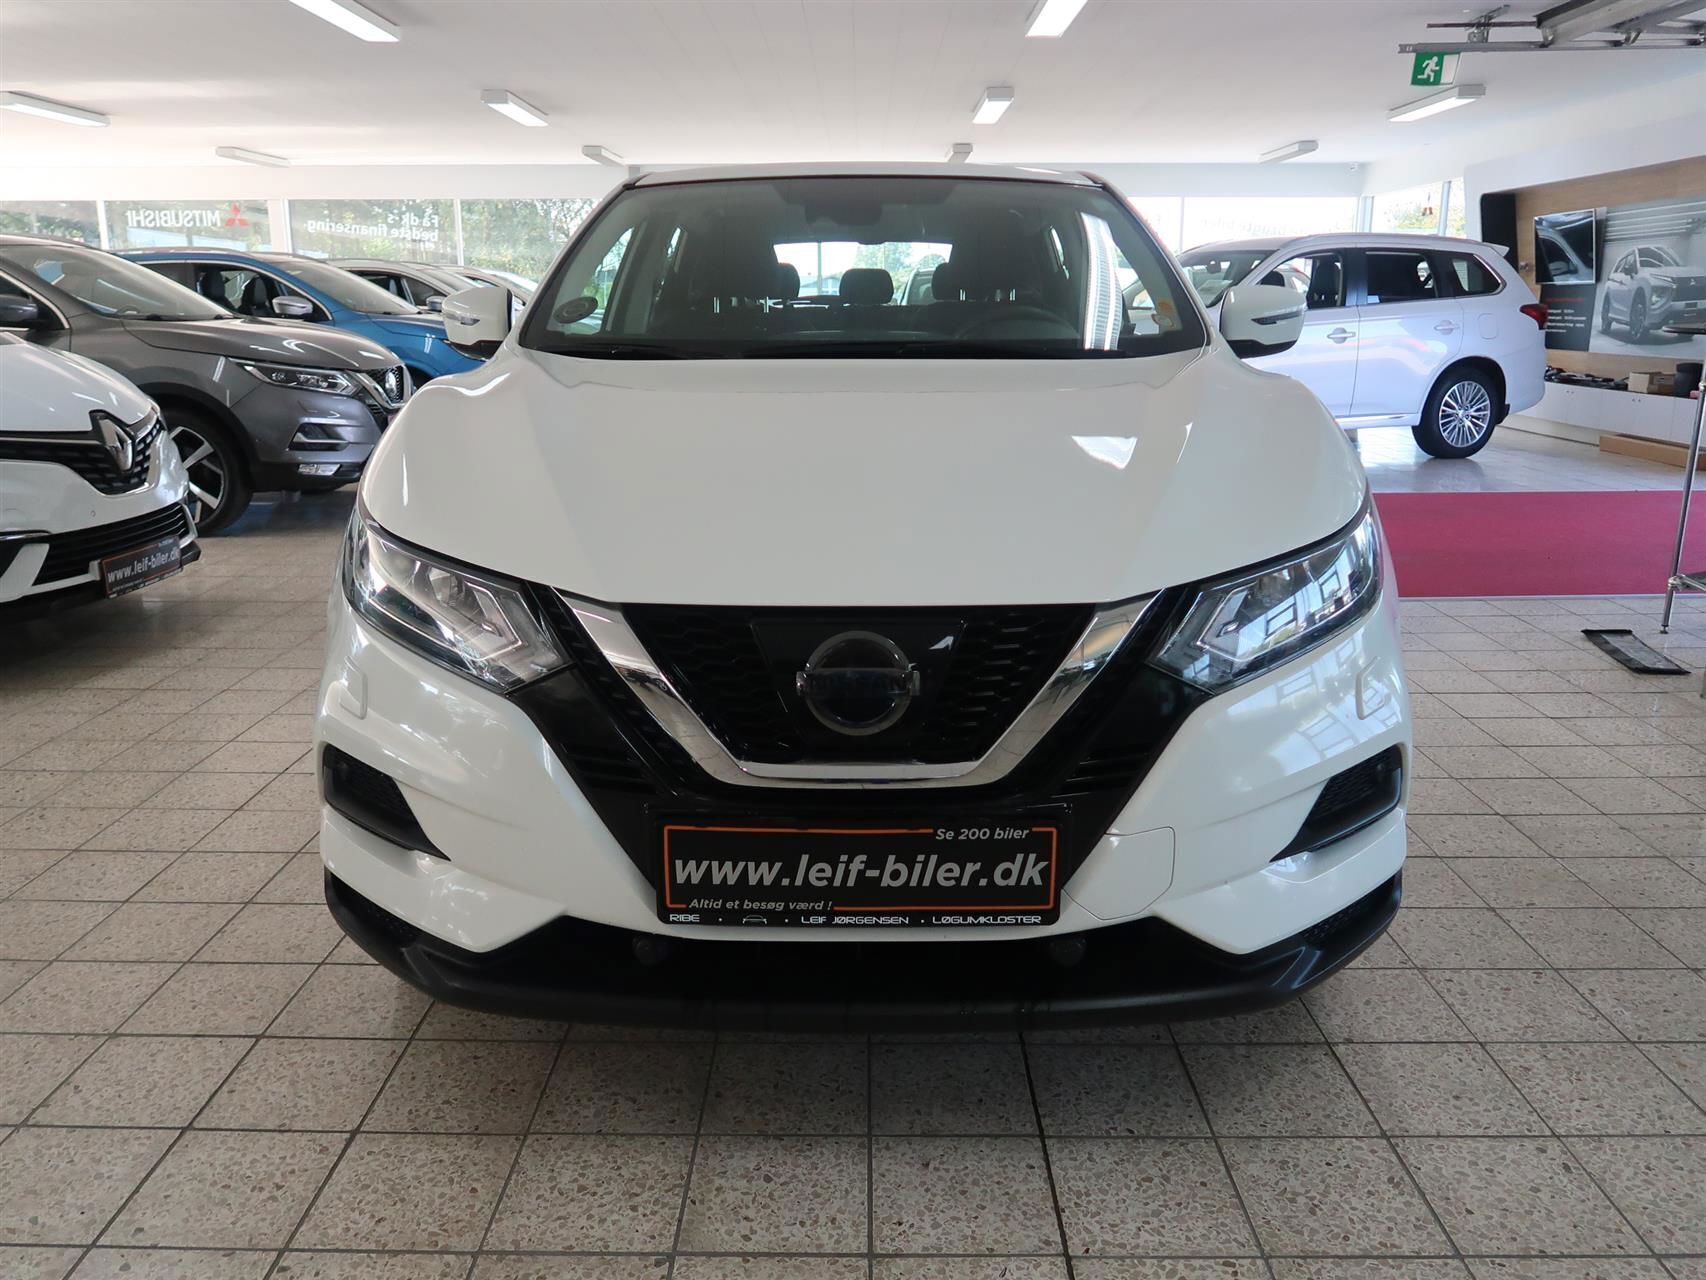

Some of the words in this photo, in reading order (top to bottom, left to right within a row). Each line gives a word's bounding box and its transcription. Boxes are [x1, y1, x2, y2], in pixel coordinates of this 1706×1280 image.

[936, 828, 955, 840] Se
[958, 828, 990, 840] 200
[994, 827, 1029, 840] biler
[674, 853, 1049, 887] www.leif-biler.dk
[688, 898, 723, 909] Altid
[725, 900, 740, 910] et
[743, 899, 784, 911] besøg
[788, 901, 825, 911] værd
[669, 913, 700, 923] RIBE
[801, 914, 828, 924] LEIF
[831, 915, 909, 925] JØRGENSEN
[932, 915, 1042, 925] LØGUMKLOSTER
